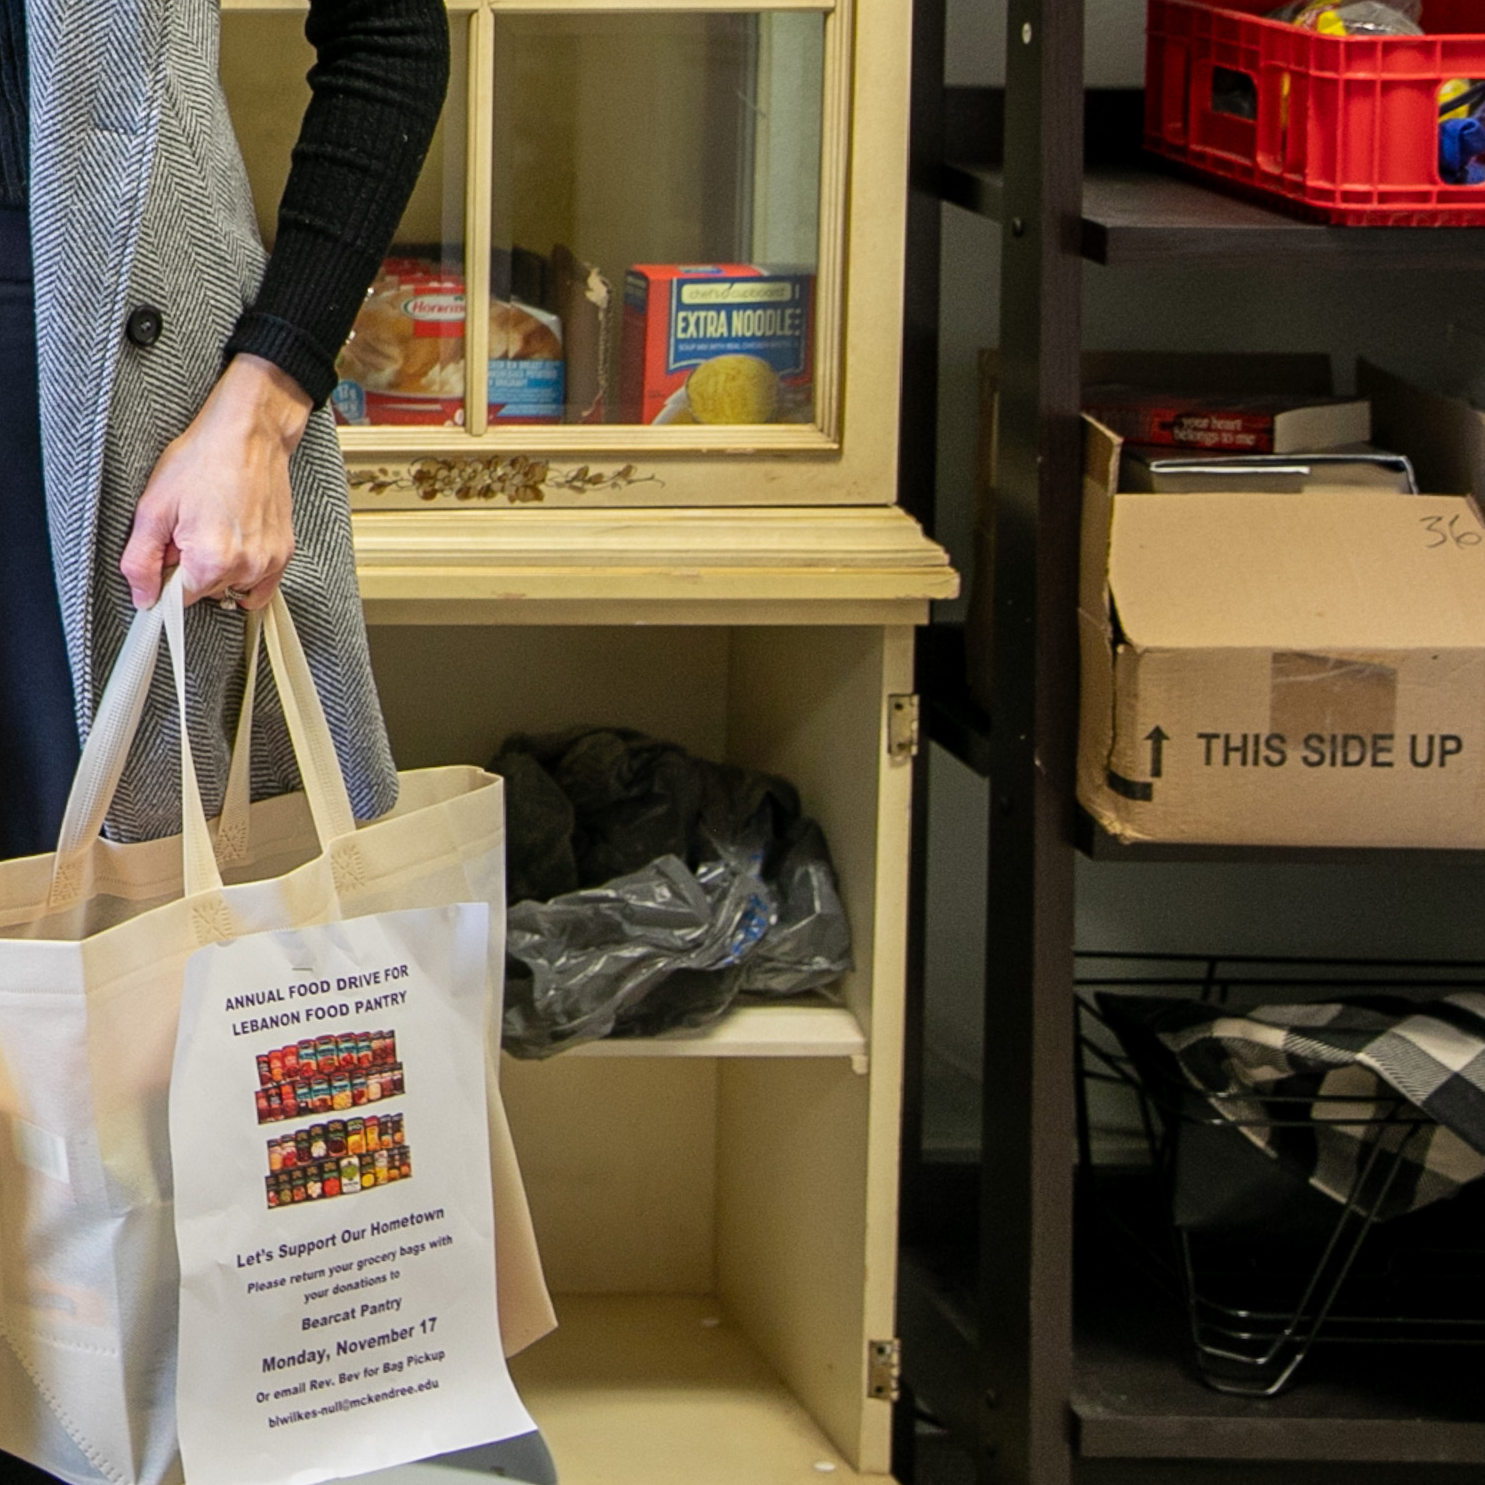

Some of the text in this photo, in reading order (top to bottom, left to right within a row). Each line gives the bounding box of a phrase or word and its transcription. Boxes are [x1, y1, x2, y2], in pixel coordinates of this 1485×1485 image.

[676, 310, 729, 339] EXTRA
[1173, 430, 1257, 445] belongs to me
[1182, 416, 1242, 432] your heart
[1197, 732, 1463, 769] THIS SIDE UP
[226, 965, 409, 1011] ANNUAL FOOD DRIVE FOR
[233, 991, 407, 1035] LEBANON FOOD PANTRY
[237, 1208, 445, 1268] Let's Support Our Hometown
[247, 1235, 453, 1294] Please return your grocery bags with
[304, 1269, 401, 1304] your donations to
[302, 1297, 402, 1330] Bearcat Pantry
[262, 1317, 438, 1372] Monday, November 17
[256, 1349, 446, 1403] Or email Rev. Bev for Bag Pickup
